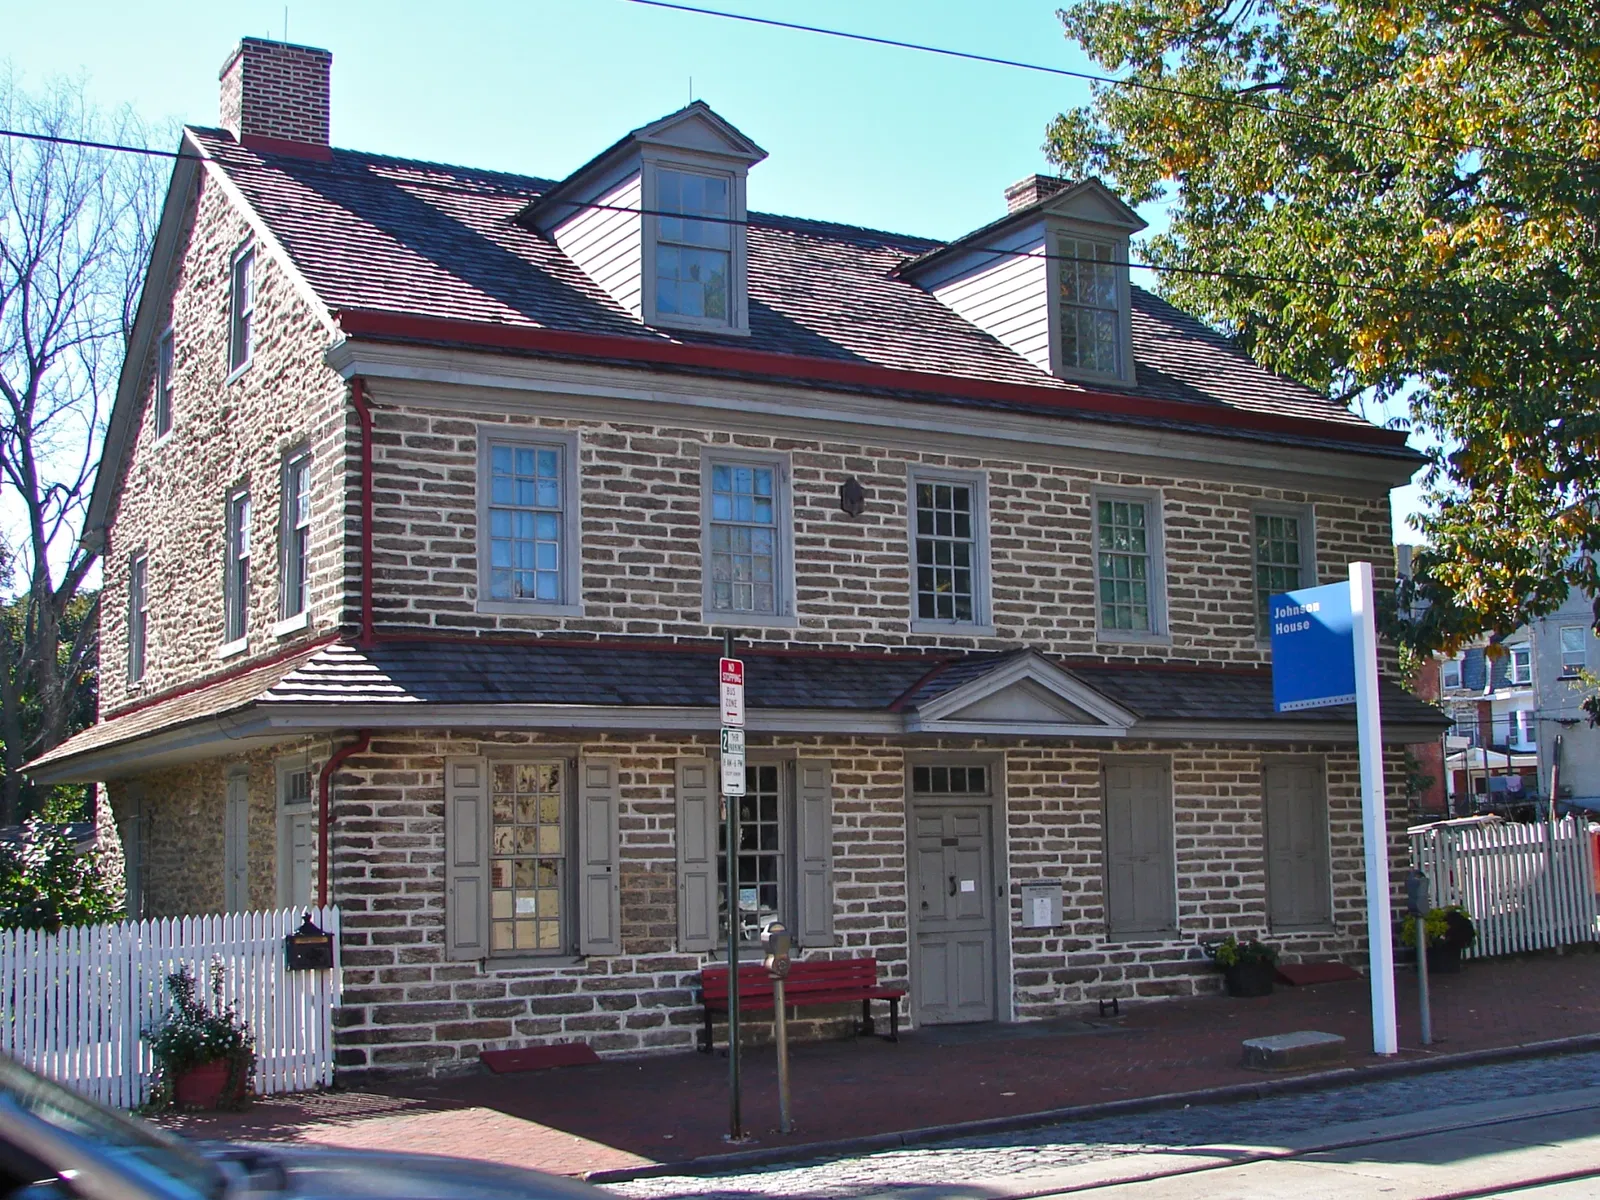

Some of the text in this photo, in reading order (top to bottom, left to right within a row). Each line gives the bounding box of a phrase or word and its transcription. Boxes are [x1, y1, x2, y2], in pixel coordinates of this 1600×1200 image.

[1274, 602, 1320, 619] Johnson
[1275, 620, 1310, 635] House
[728, 663, 735, 672] NO
[726, 686, 736, 696] BUS
[725, 698, 738, 708] ZONE
[723, 733, 728, 750] 2
